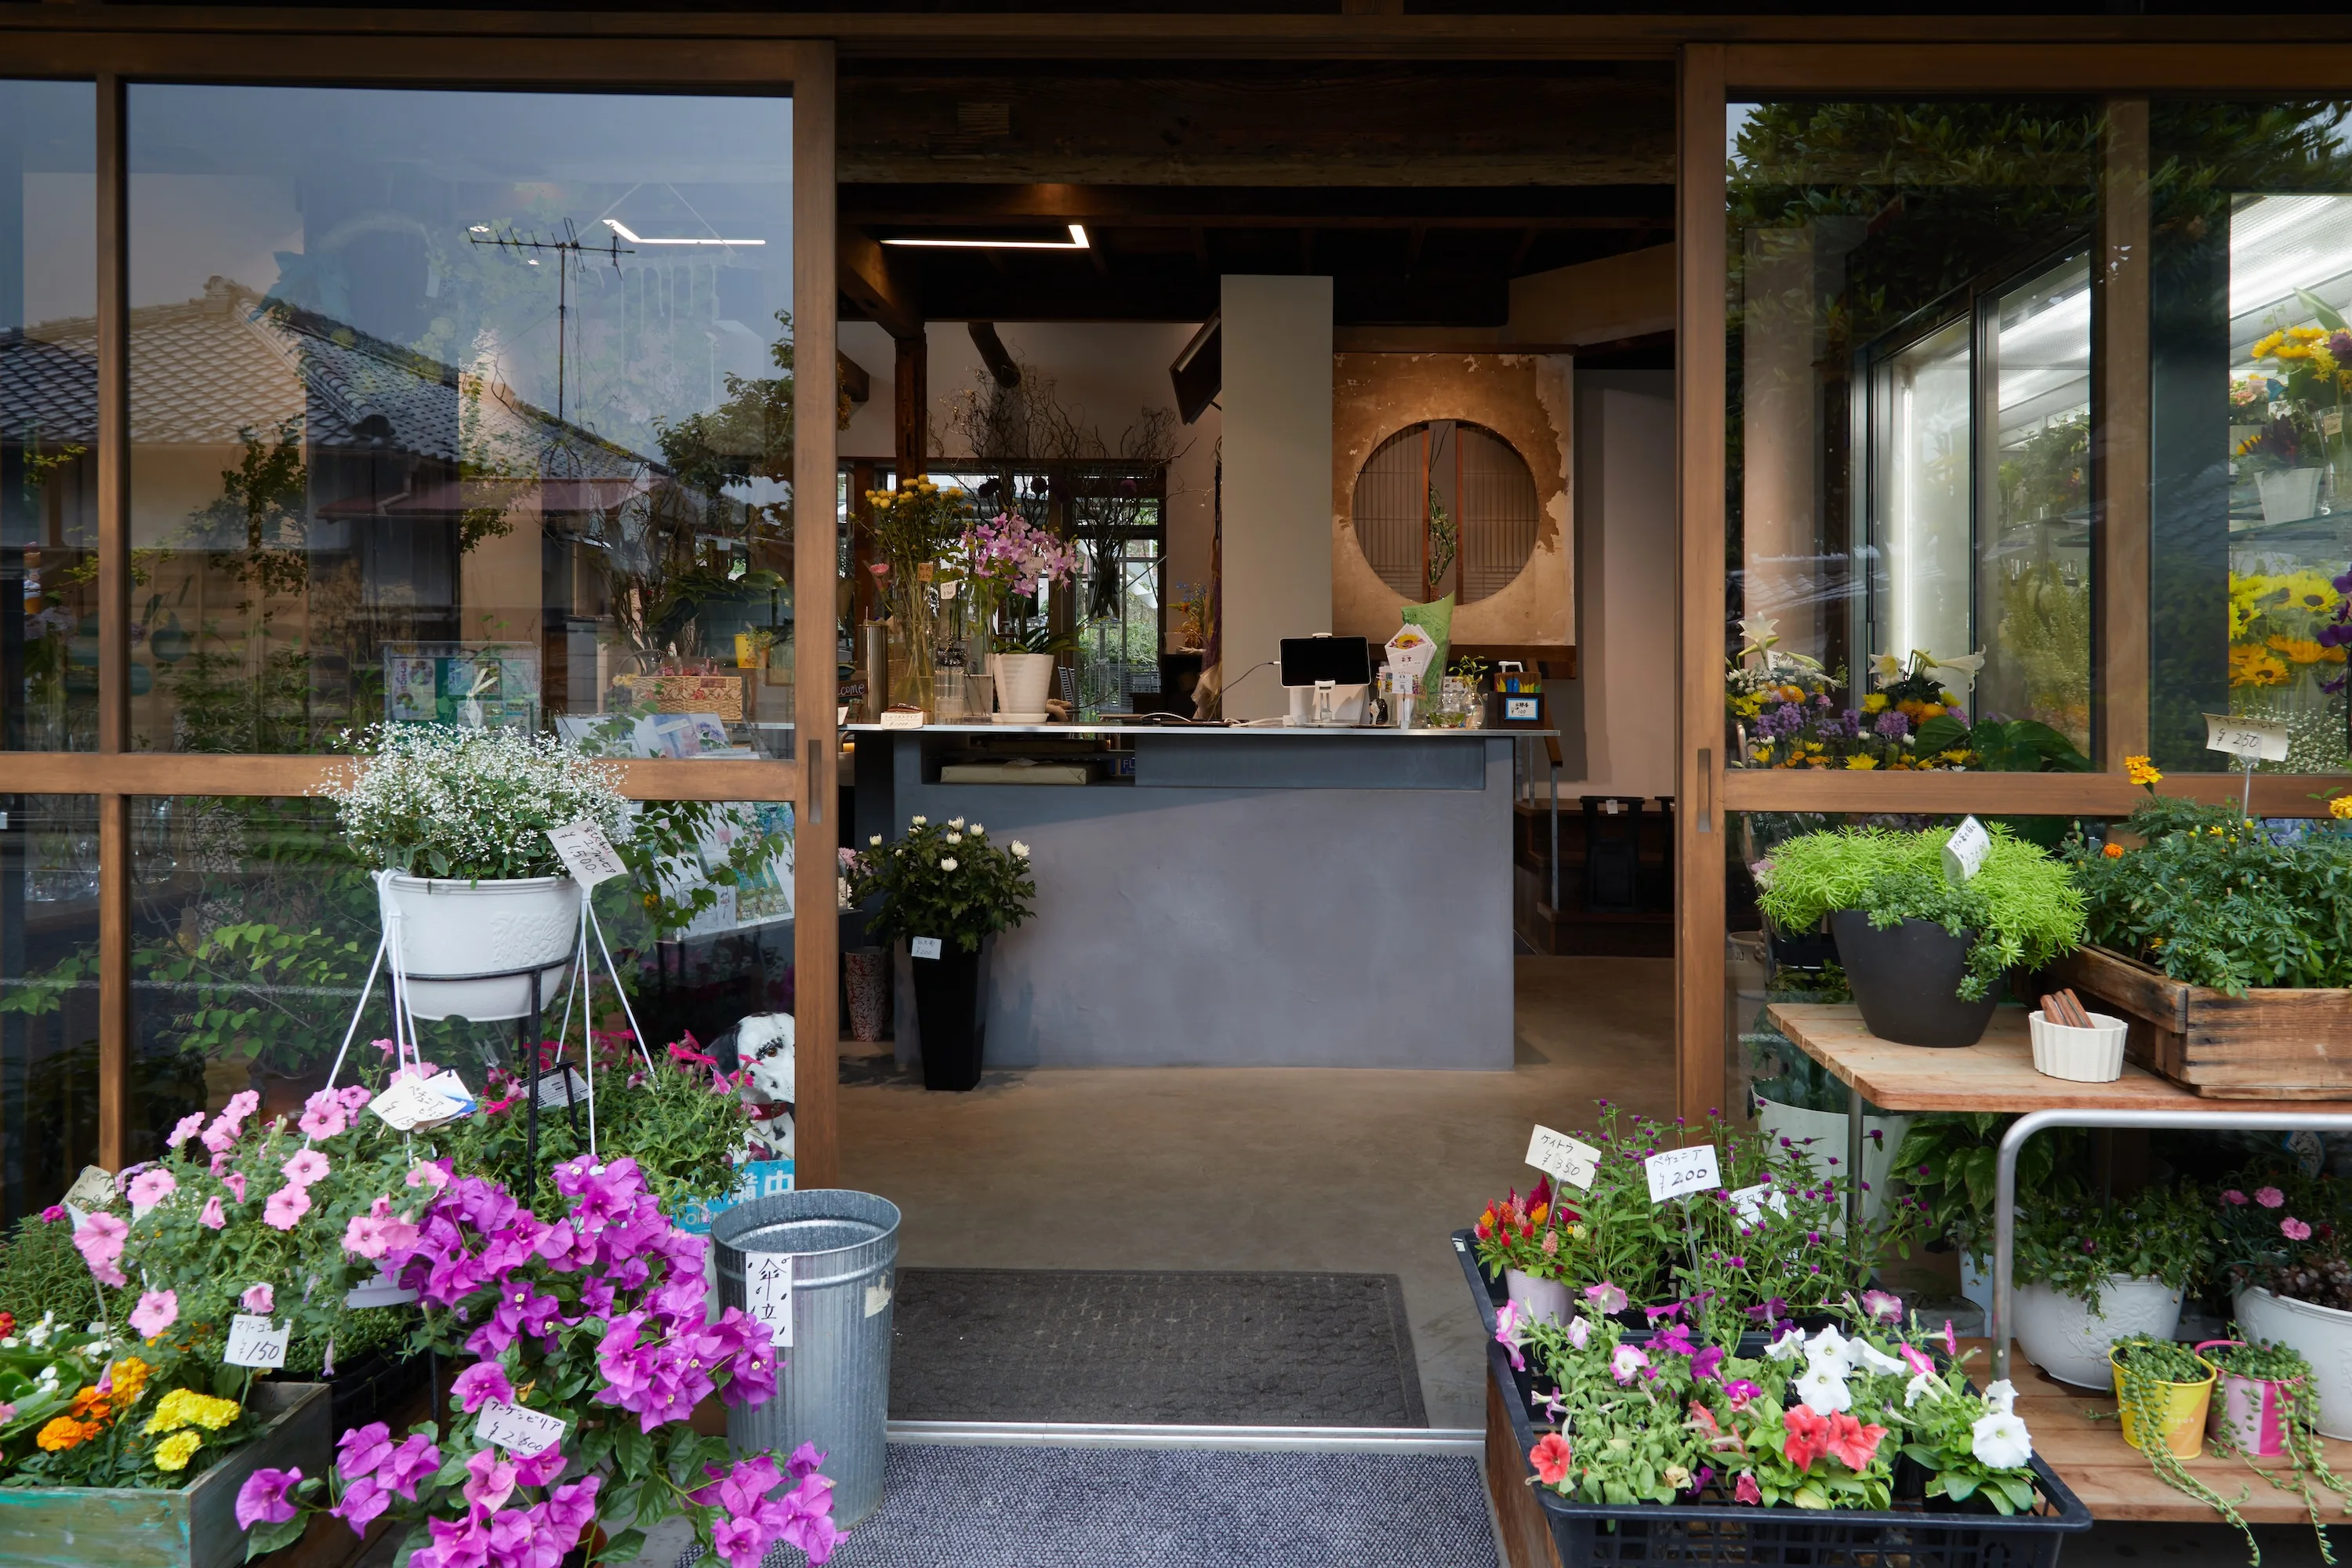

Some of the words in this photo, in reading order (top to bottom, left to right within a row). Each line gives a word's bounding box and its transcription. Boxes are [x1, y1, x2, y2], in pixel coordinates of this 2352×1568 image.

[838, 684, 865, 695] come
[1541, 1134, 1573, 1154] ケイトウ
[1653, 1149, 1703, 1167] ペチュニア
[759, 1258, 786, 1343] 傘立
